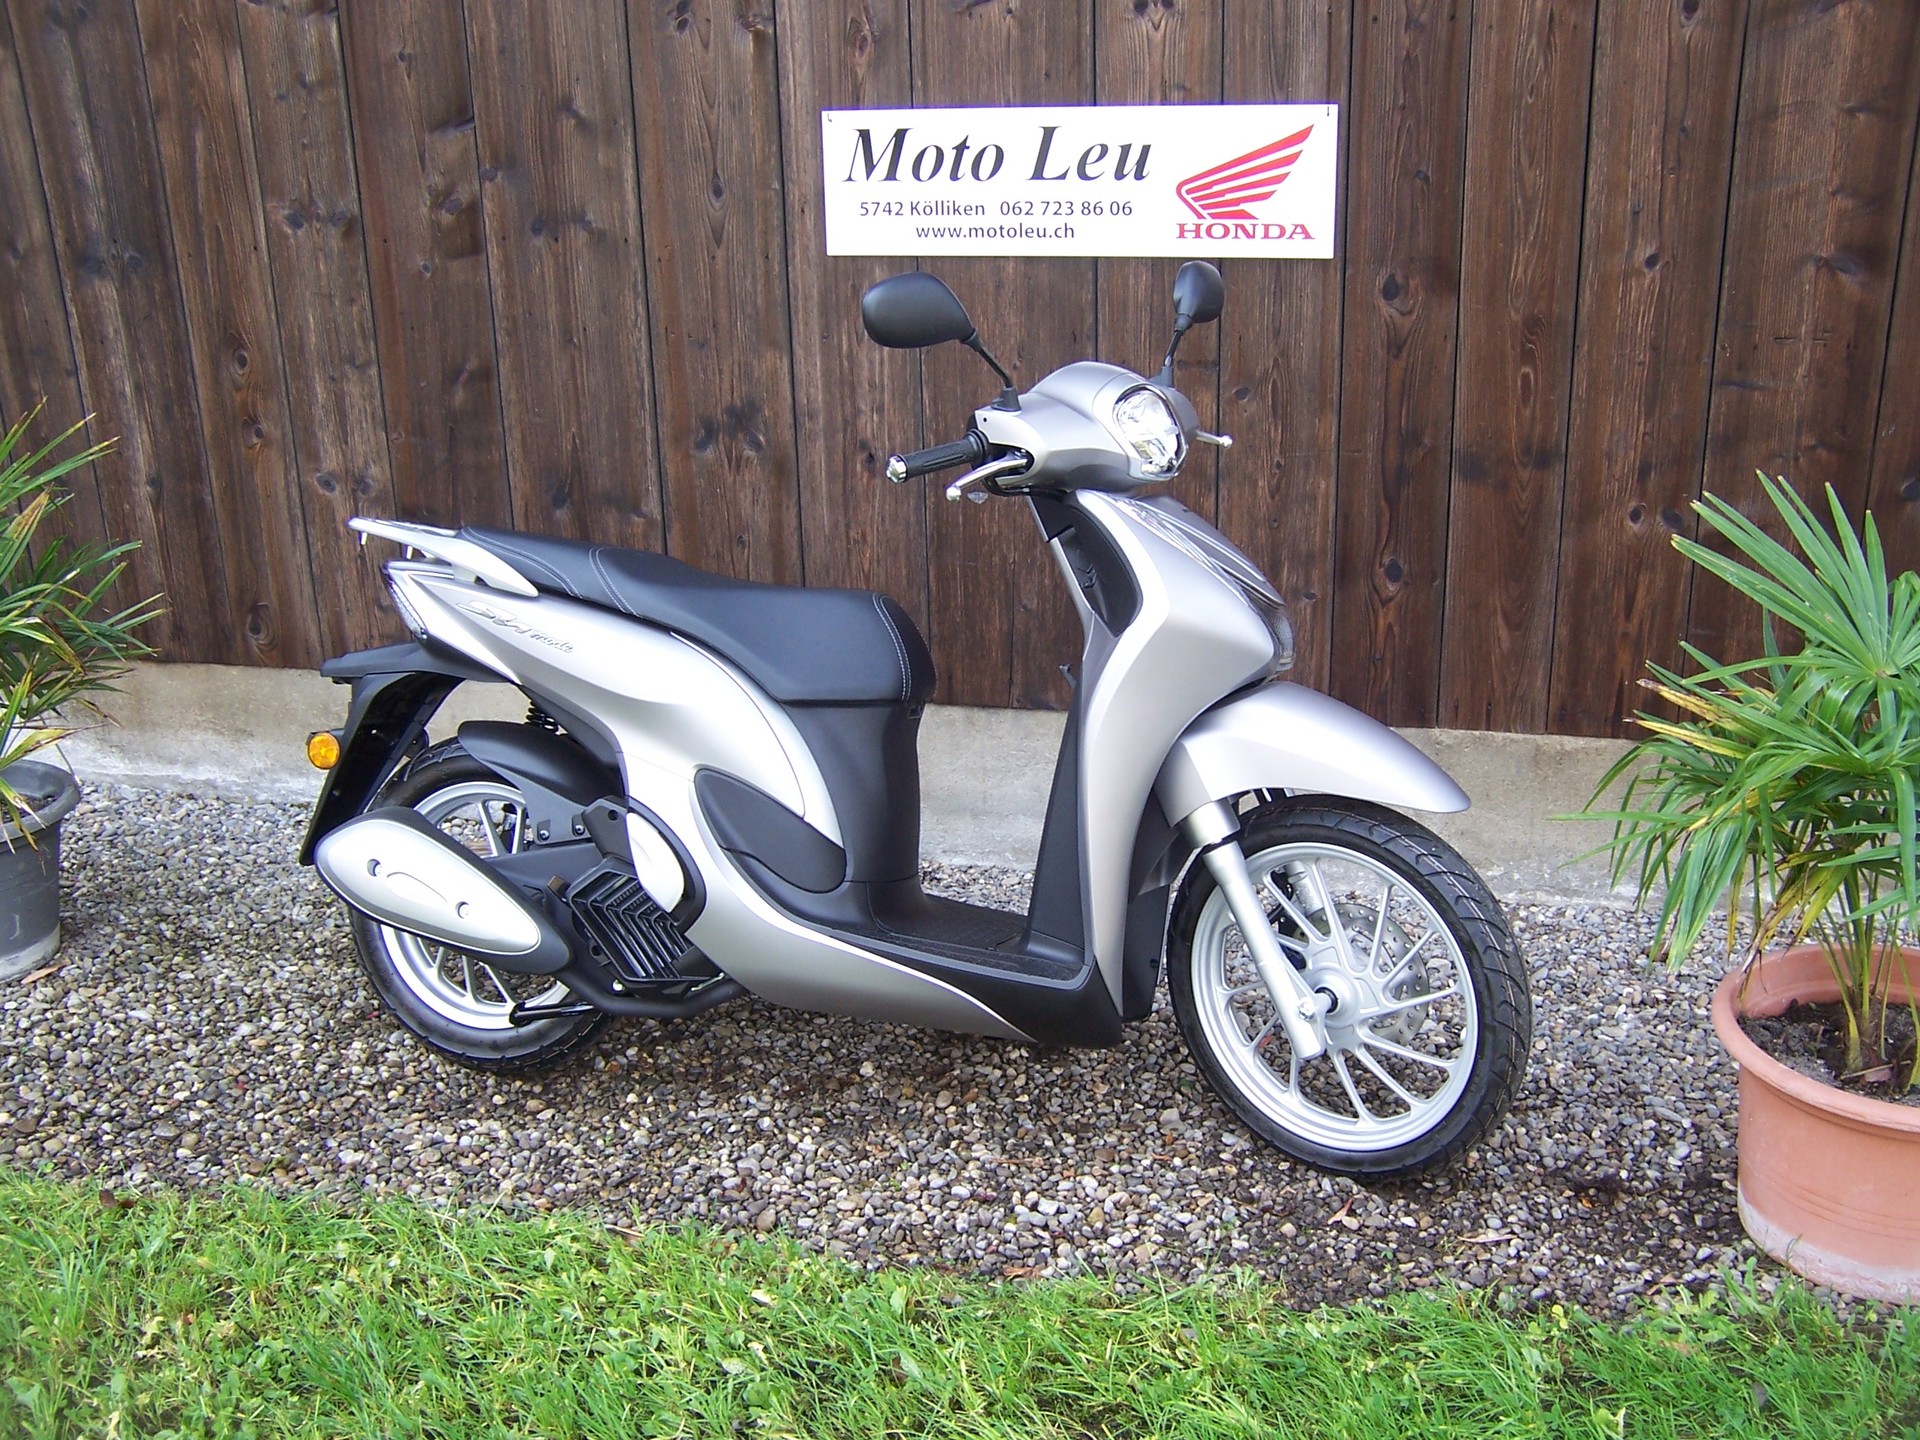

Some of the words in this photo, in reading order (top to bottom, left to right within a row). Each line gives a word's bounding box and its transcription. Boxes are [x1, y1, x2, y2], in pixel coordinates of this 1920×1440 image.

[843, 127, 1006, 183] Moto
[1026, 125, 1153, 182] Leu
[859, 200, 905, 217] 5742
[910, 199, 986, 217] Kölliken
[999, 200, 1034, 216] 062
[1040, 200, 1075, 216] 723
[1080, 200, 1104, 216] 86
[1109, 200, 1133, 216] 06
[915, 222, 1075, 239] www.motoleu.ch
[1175, 222, 1315, 240] HONDA
